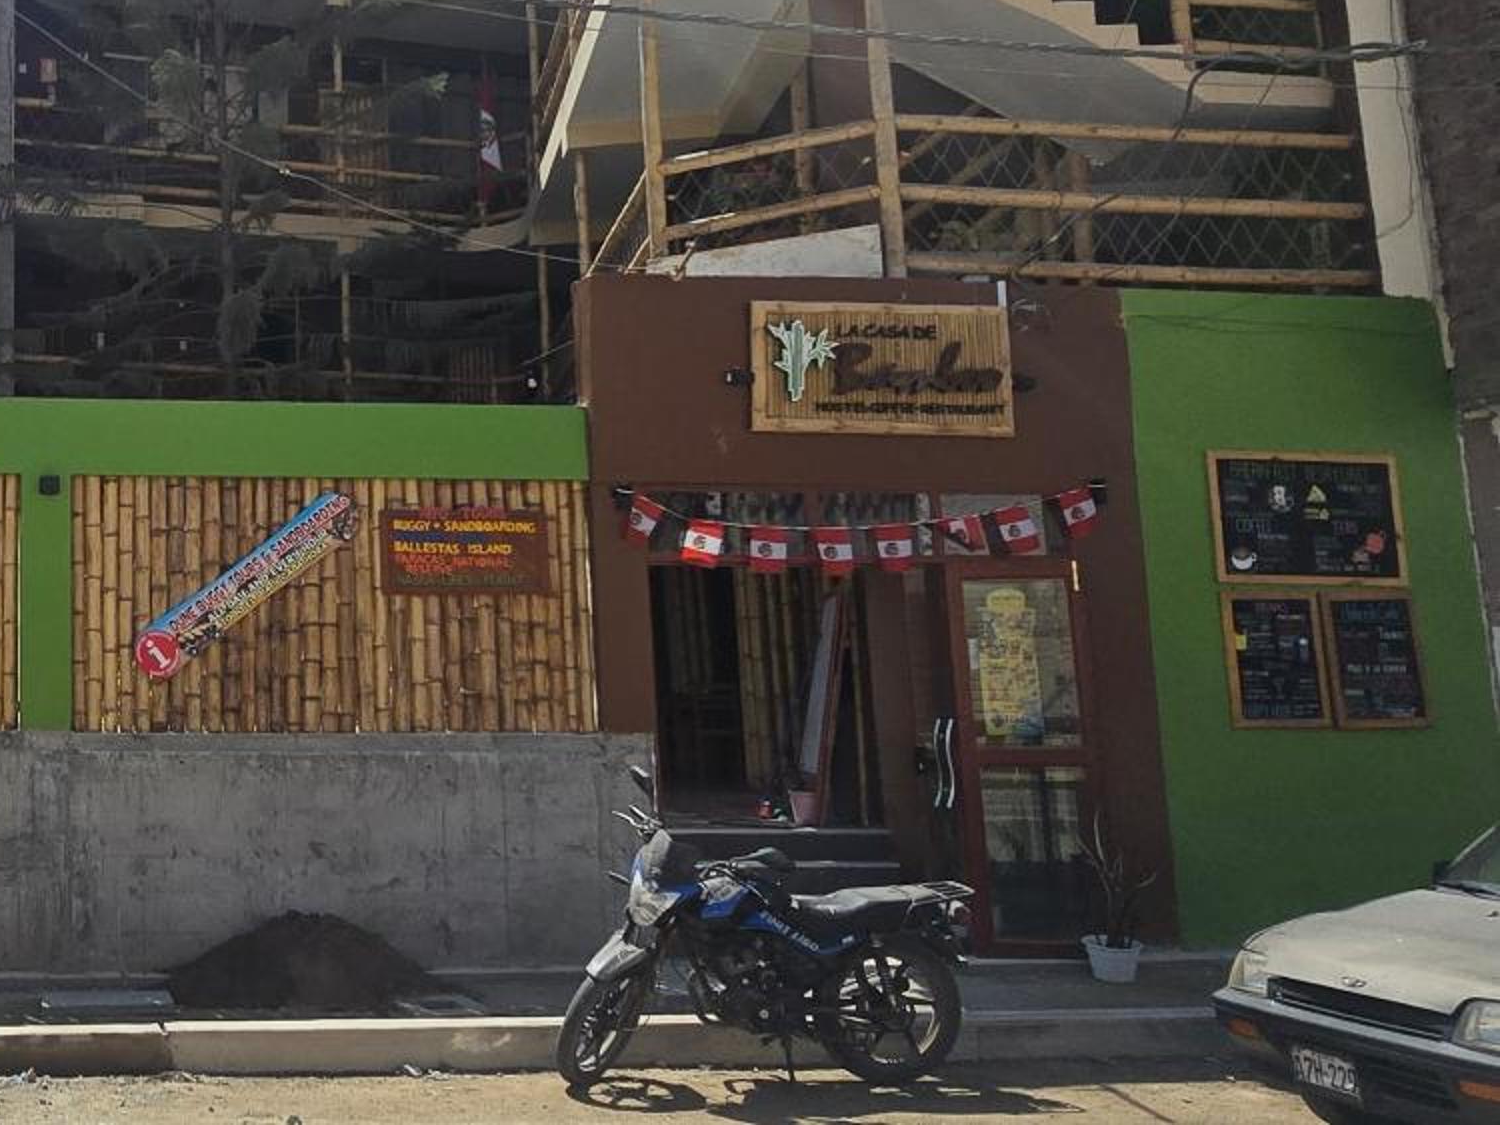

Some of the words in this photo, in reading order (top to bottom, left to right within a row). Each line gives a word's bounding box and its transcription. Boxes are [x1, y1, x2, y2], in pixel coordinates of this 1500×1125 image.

[838, 325, 864, 338] LA
[865, 324, 911, 339] CASA
[912, 325, 937, 340] DE
[393, 520, 431, 531] BUGGY
[443, 521, 537, 534] SANDBOARDING
[196, 582, 231, 613] BUGGY
[229, 556, 265, 588] TOURS
[272, 493, 351, 556] SANDBOARDING
[393, 541, 461, 555] BALLESTAS
[467, 544, 513, 556] ISLAND
[247, 572, 270, 592] AND
